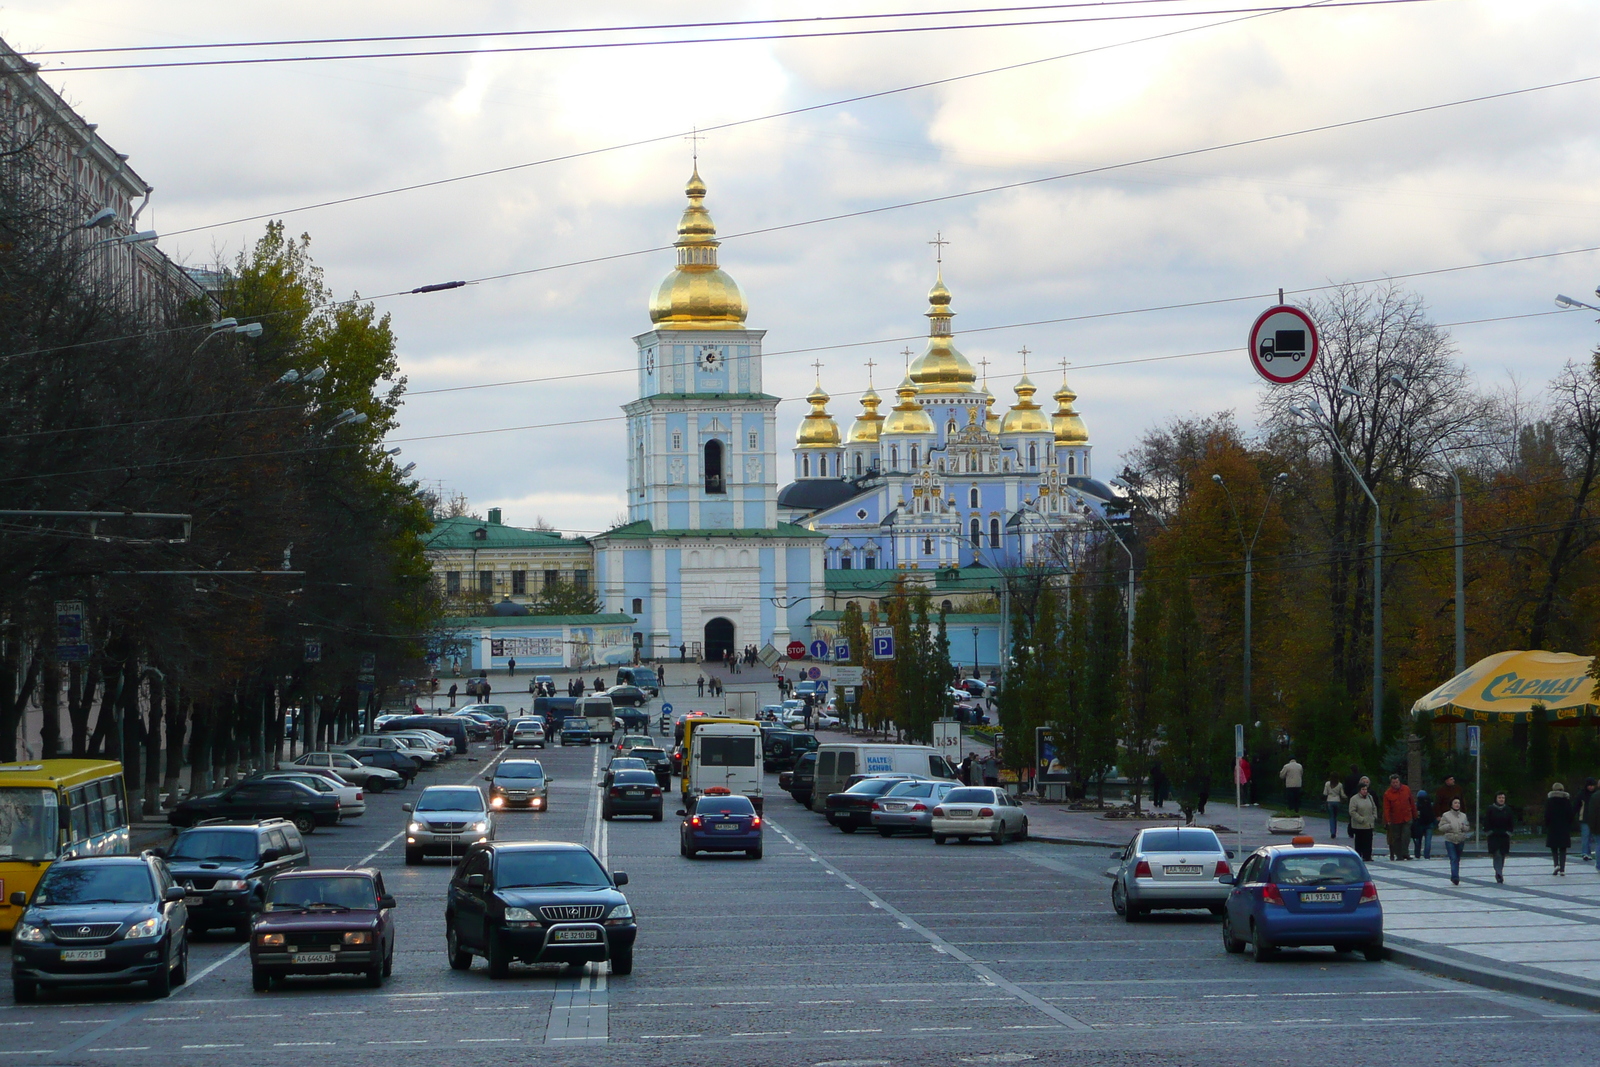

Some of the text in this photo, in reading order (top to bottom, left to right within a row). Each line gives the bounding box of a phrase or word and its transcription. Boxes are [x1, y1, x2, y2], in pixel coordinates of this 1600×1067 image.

[839, 647, 846, 659] P
[879, 639, 888, 655] P
[1481, 671, 1590, 702] САРМАТ
